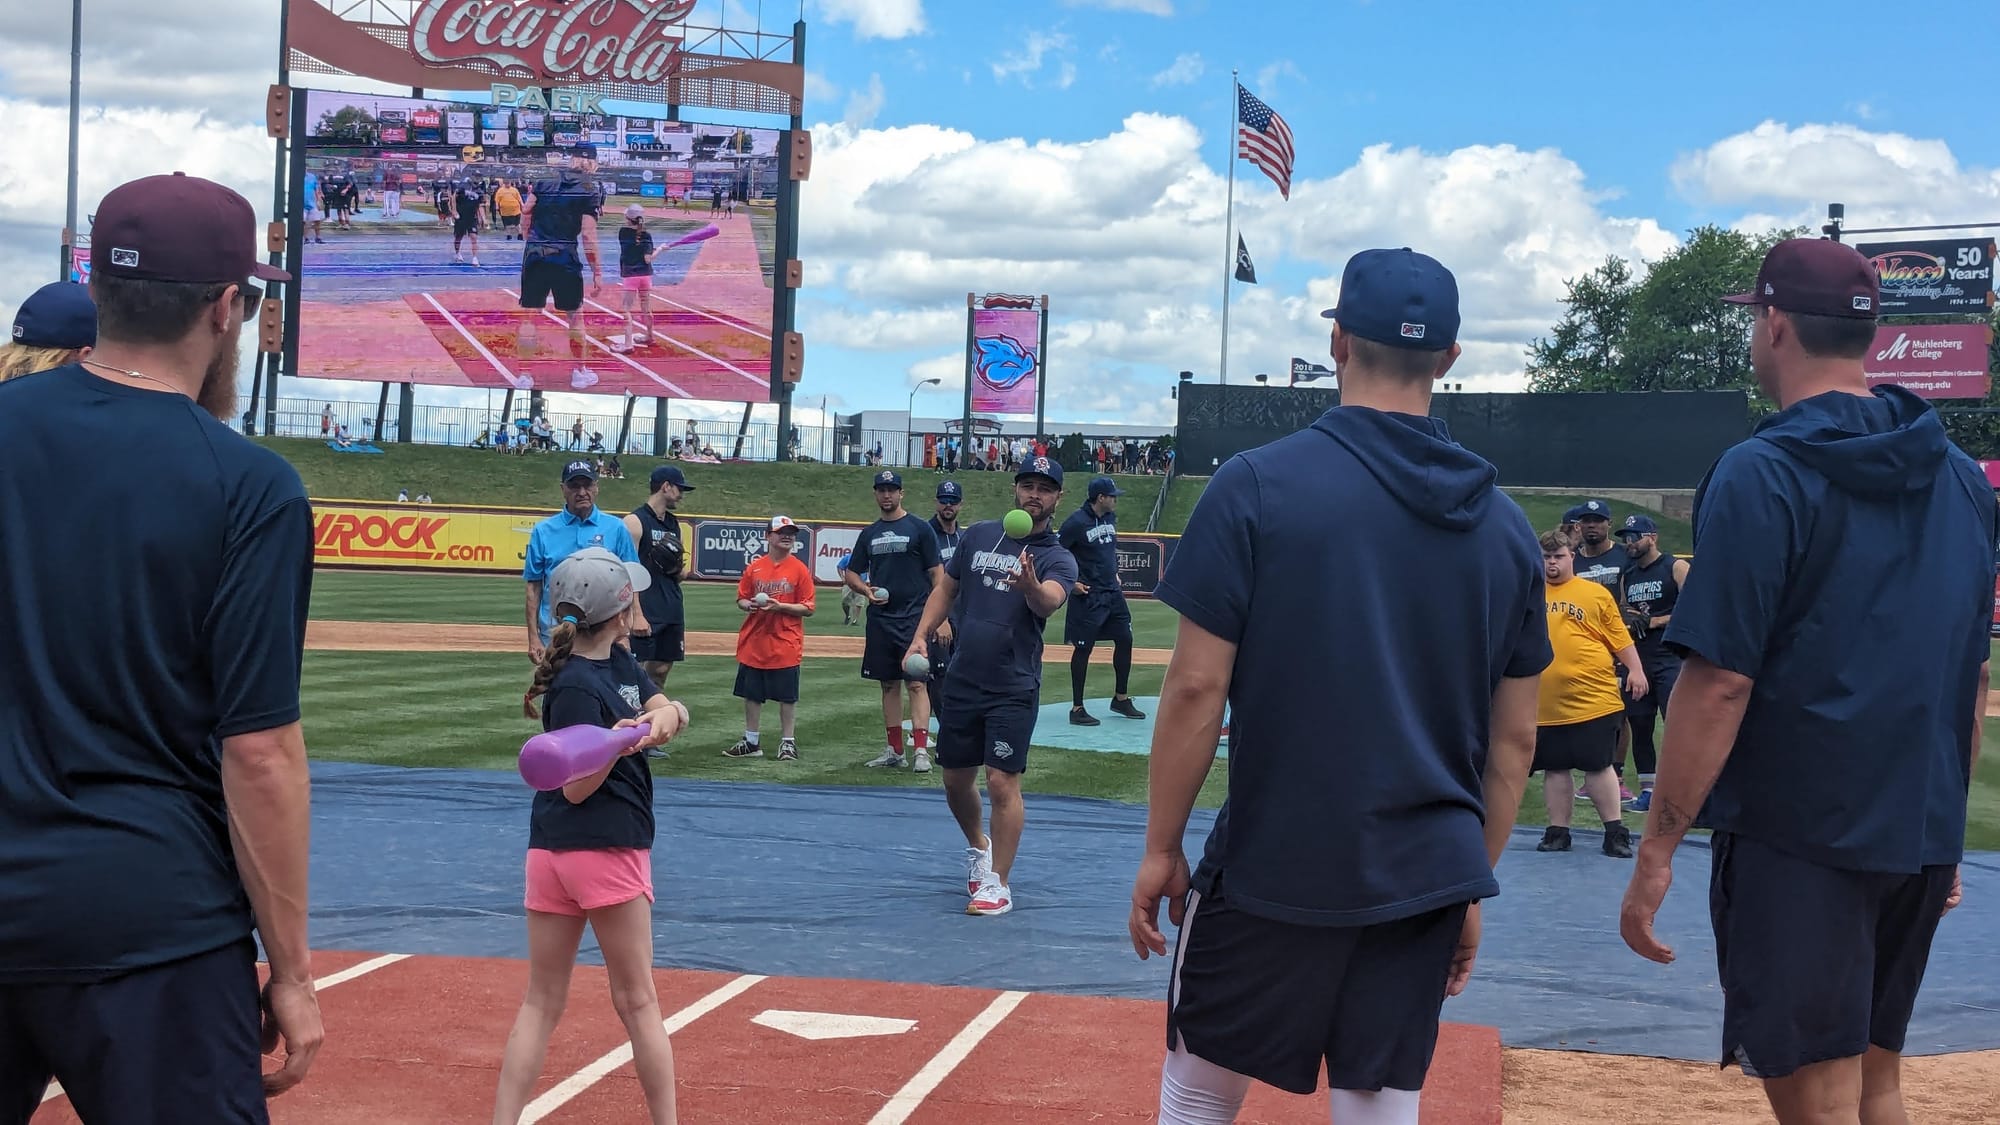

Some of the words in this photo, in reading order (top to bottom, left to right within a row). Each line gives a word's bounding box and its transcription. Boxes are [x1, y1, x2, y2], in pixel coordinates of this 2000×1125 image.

[413, 0, 692, 82] Coca-Cola
[491, 83, 607, 115] PARK
[1957, 247, 1982, 267] 50
[1875, 257, 1945, 286] Nacci
[1947, 267, 1989, 280] Years!
[1912, 339, 1963, 350] Muhlenberg
[1911, 350, 1942, 360] College
[720, 528, 737, 538] on
[741, 529, 767, 541] you
[705, 538, 745, 551] DUAL
[818, 544, 853, 557] Ame
[743, 550, 763, 566] te
[1117, 554, 1151, 568] Hotel
[1546, 601, 1584, 621] ATES
